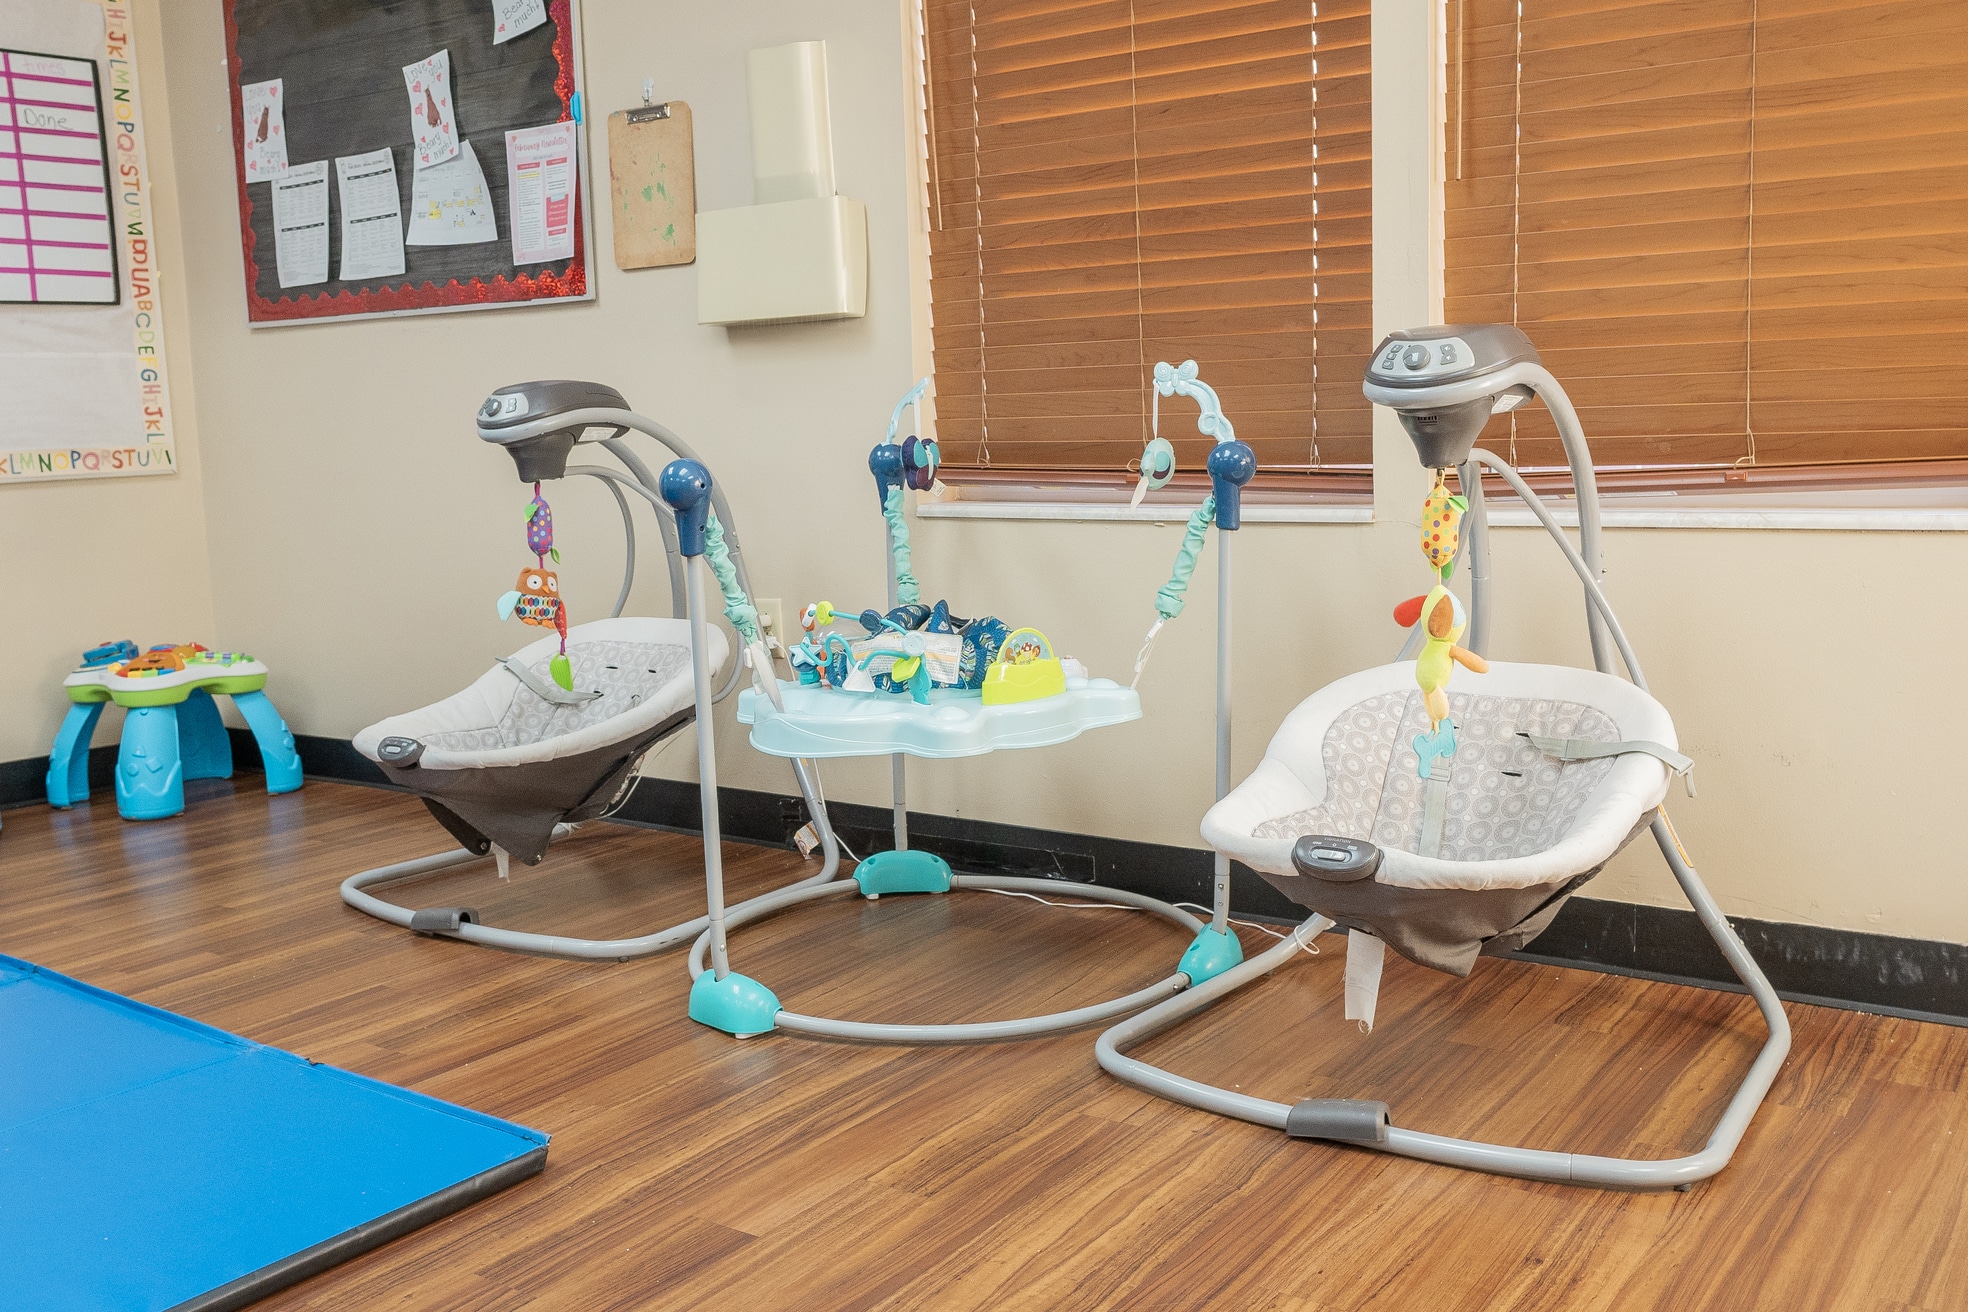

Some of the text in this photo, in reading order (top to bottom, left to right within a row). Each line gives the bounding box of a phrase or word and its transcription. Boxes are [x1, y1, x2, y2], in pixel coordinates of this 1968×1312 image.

[405, 59, 443, 84] Love you
[23, 108, 73, 130] Done
[417, 131, 441, 155] Beary
